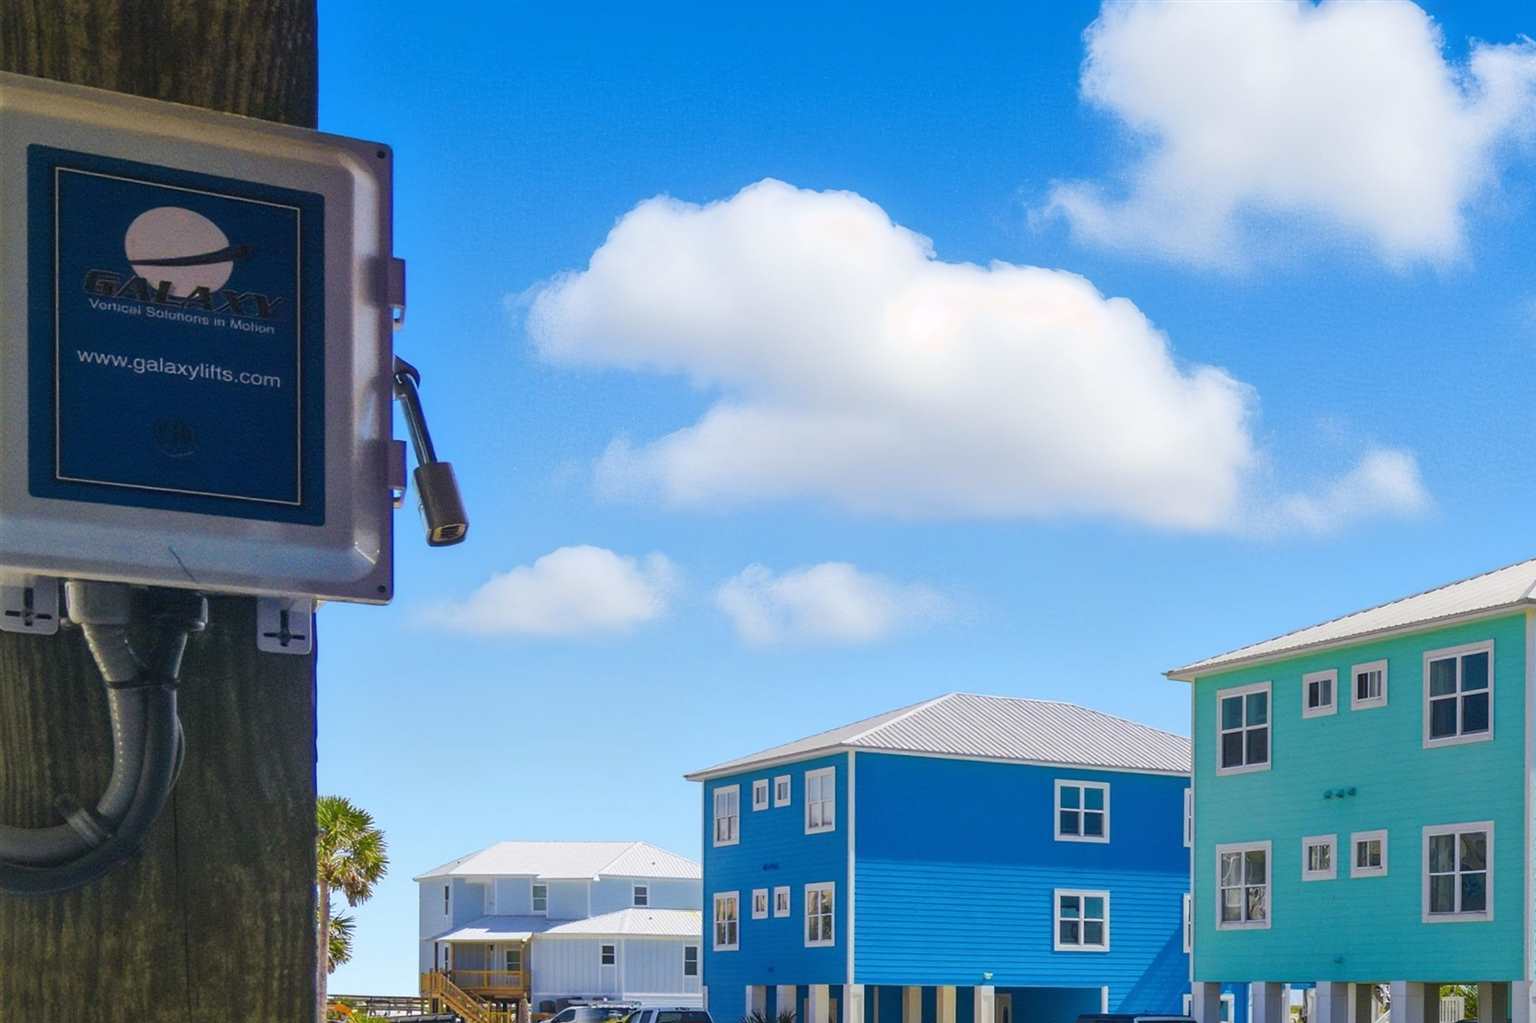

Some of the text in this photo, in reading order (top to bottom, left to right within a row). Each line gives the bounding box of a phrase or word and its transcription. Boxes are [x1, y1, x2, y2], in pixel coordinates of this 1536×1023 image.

[85, 270, 286, 318] GALAXY
[89, 298, 275, 335] Vertical Solutions in Motion
[77, 350, 281, 388] www.galaxylifts.com
